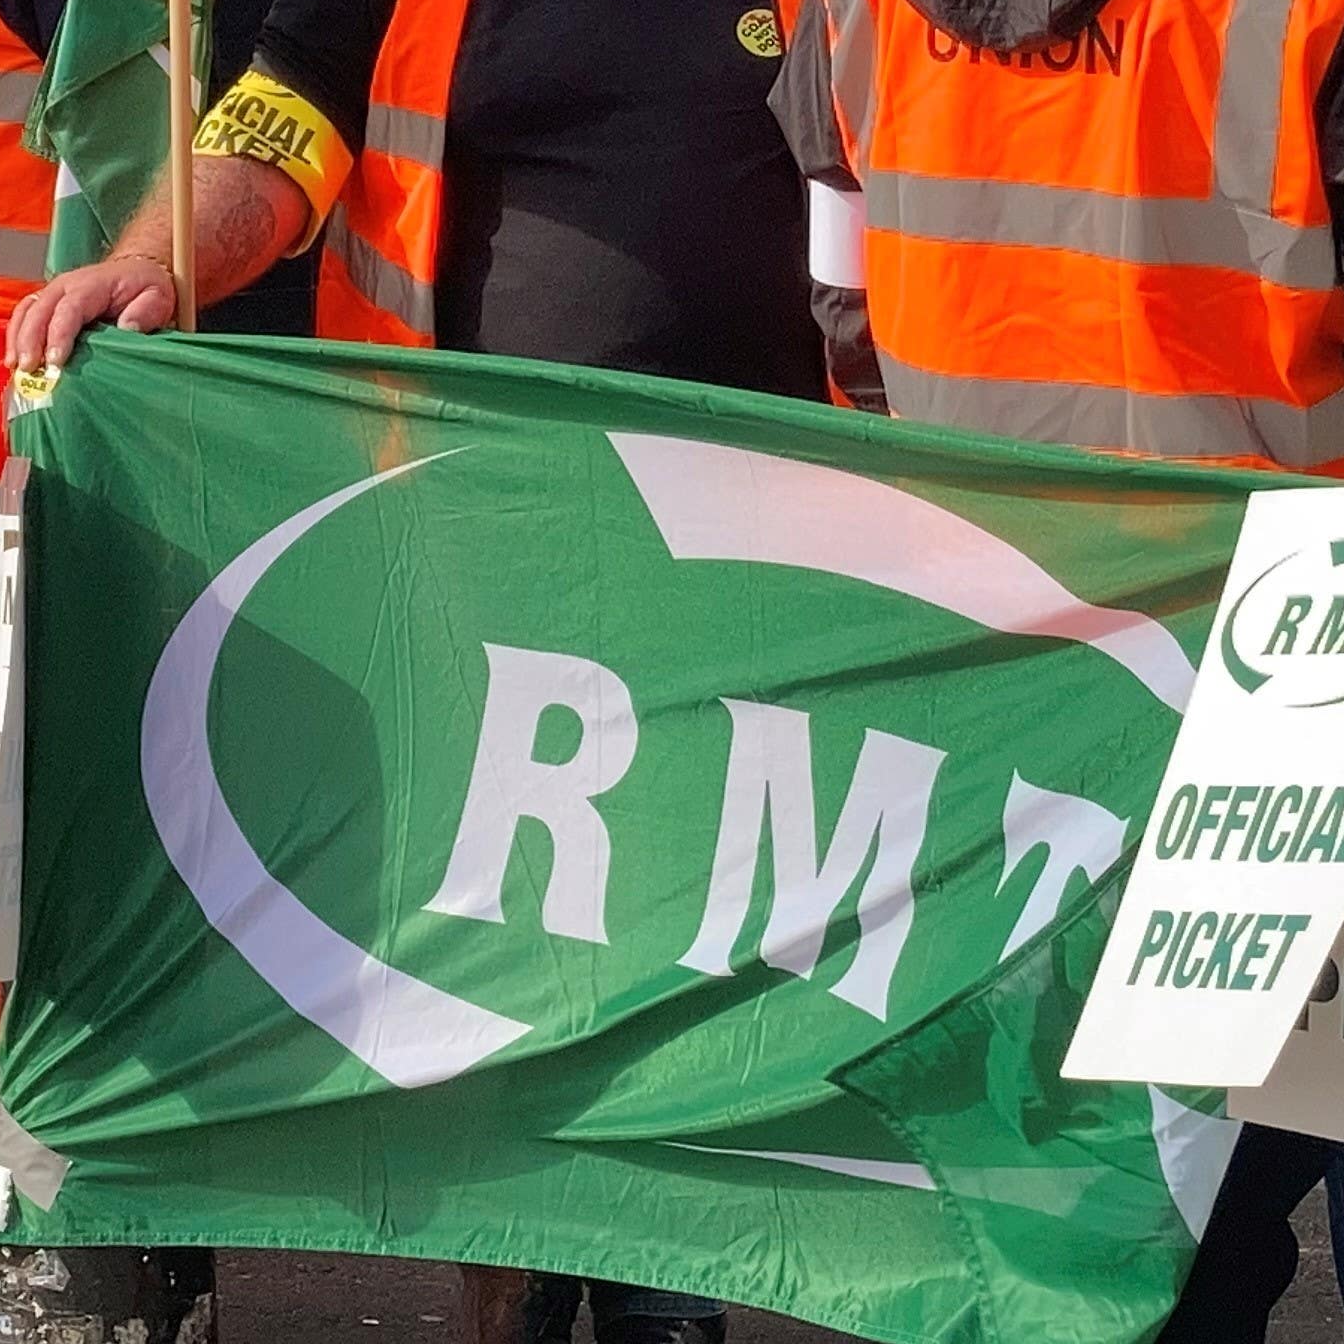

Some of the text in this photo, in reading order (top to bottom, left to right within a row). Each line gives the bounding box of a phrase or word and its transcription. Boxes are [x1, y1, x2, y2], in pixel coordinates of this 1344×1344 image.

[926, 17, 1126, 77] UON
[421, 641, 1131, 1023] RMT
[1126, 909, 1313, 992] PICKET
